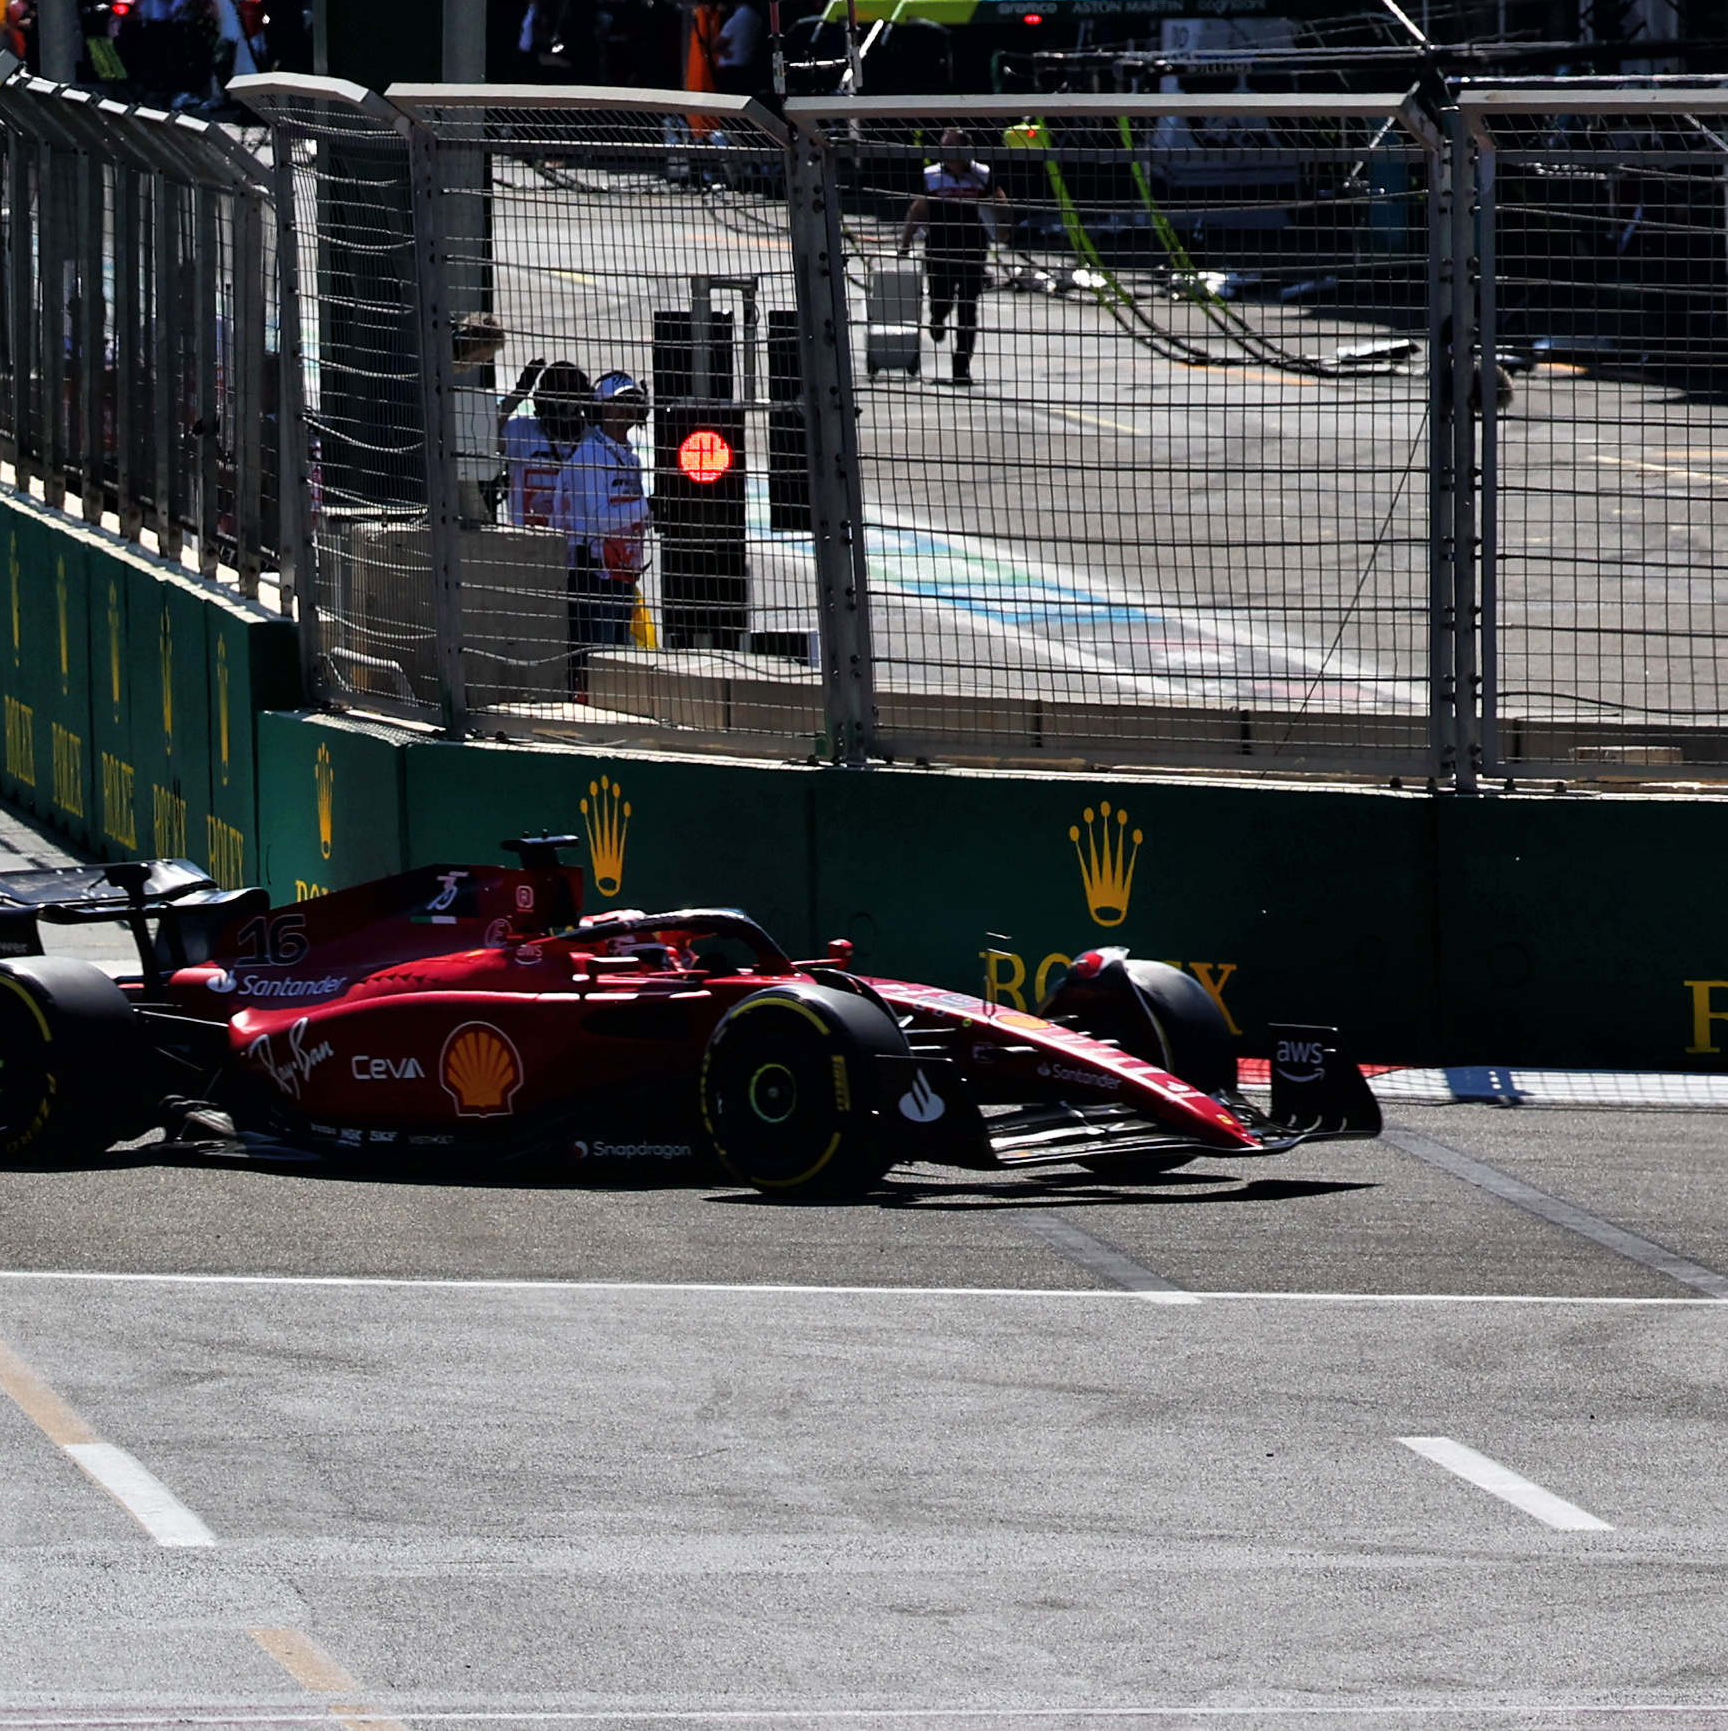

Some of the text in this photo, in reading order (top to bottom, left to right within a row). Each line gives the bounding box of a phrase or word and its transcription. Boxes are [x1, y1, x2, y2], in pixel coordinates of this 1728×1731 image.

[1071, 0, 1123, 14] ASTON
[1125, 0, 1185, 13] MARTIN
[236, 912, 309, 968] 16
[237, 974, 348, 998] Santander
[1276, 1040, 1324, 1065] aws
[1052, 1063, 1122, 1090] Santander
[593, 1141, 692, 1160] Snapdragon
